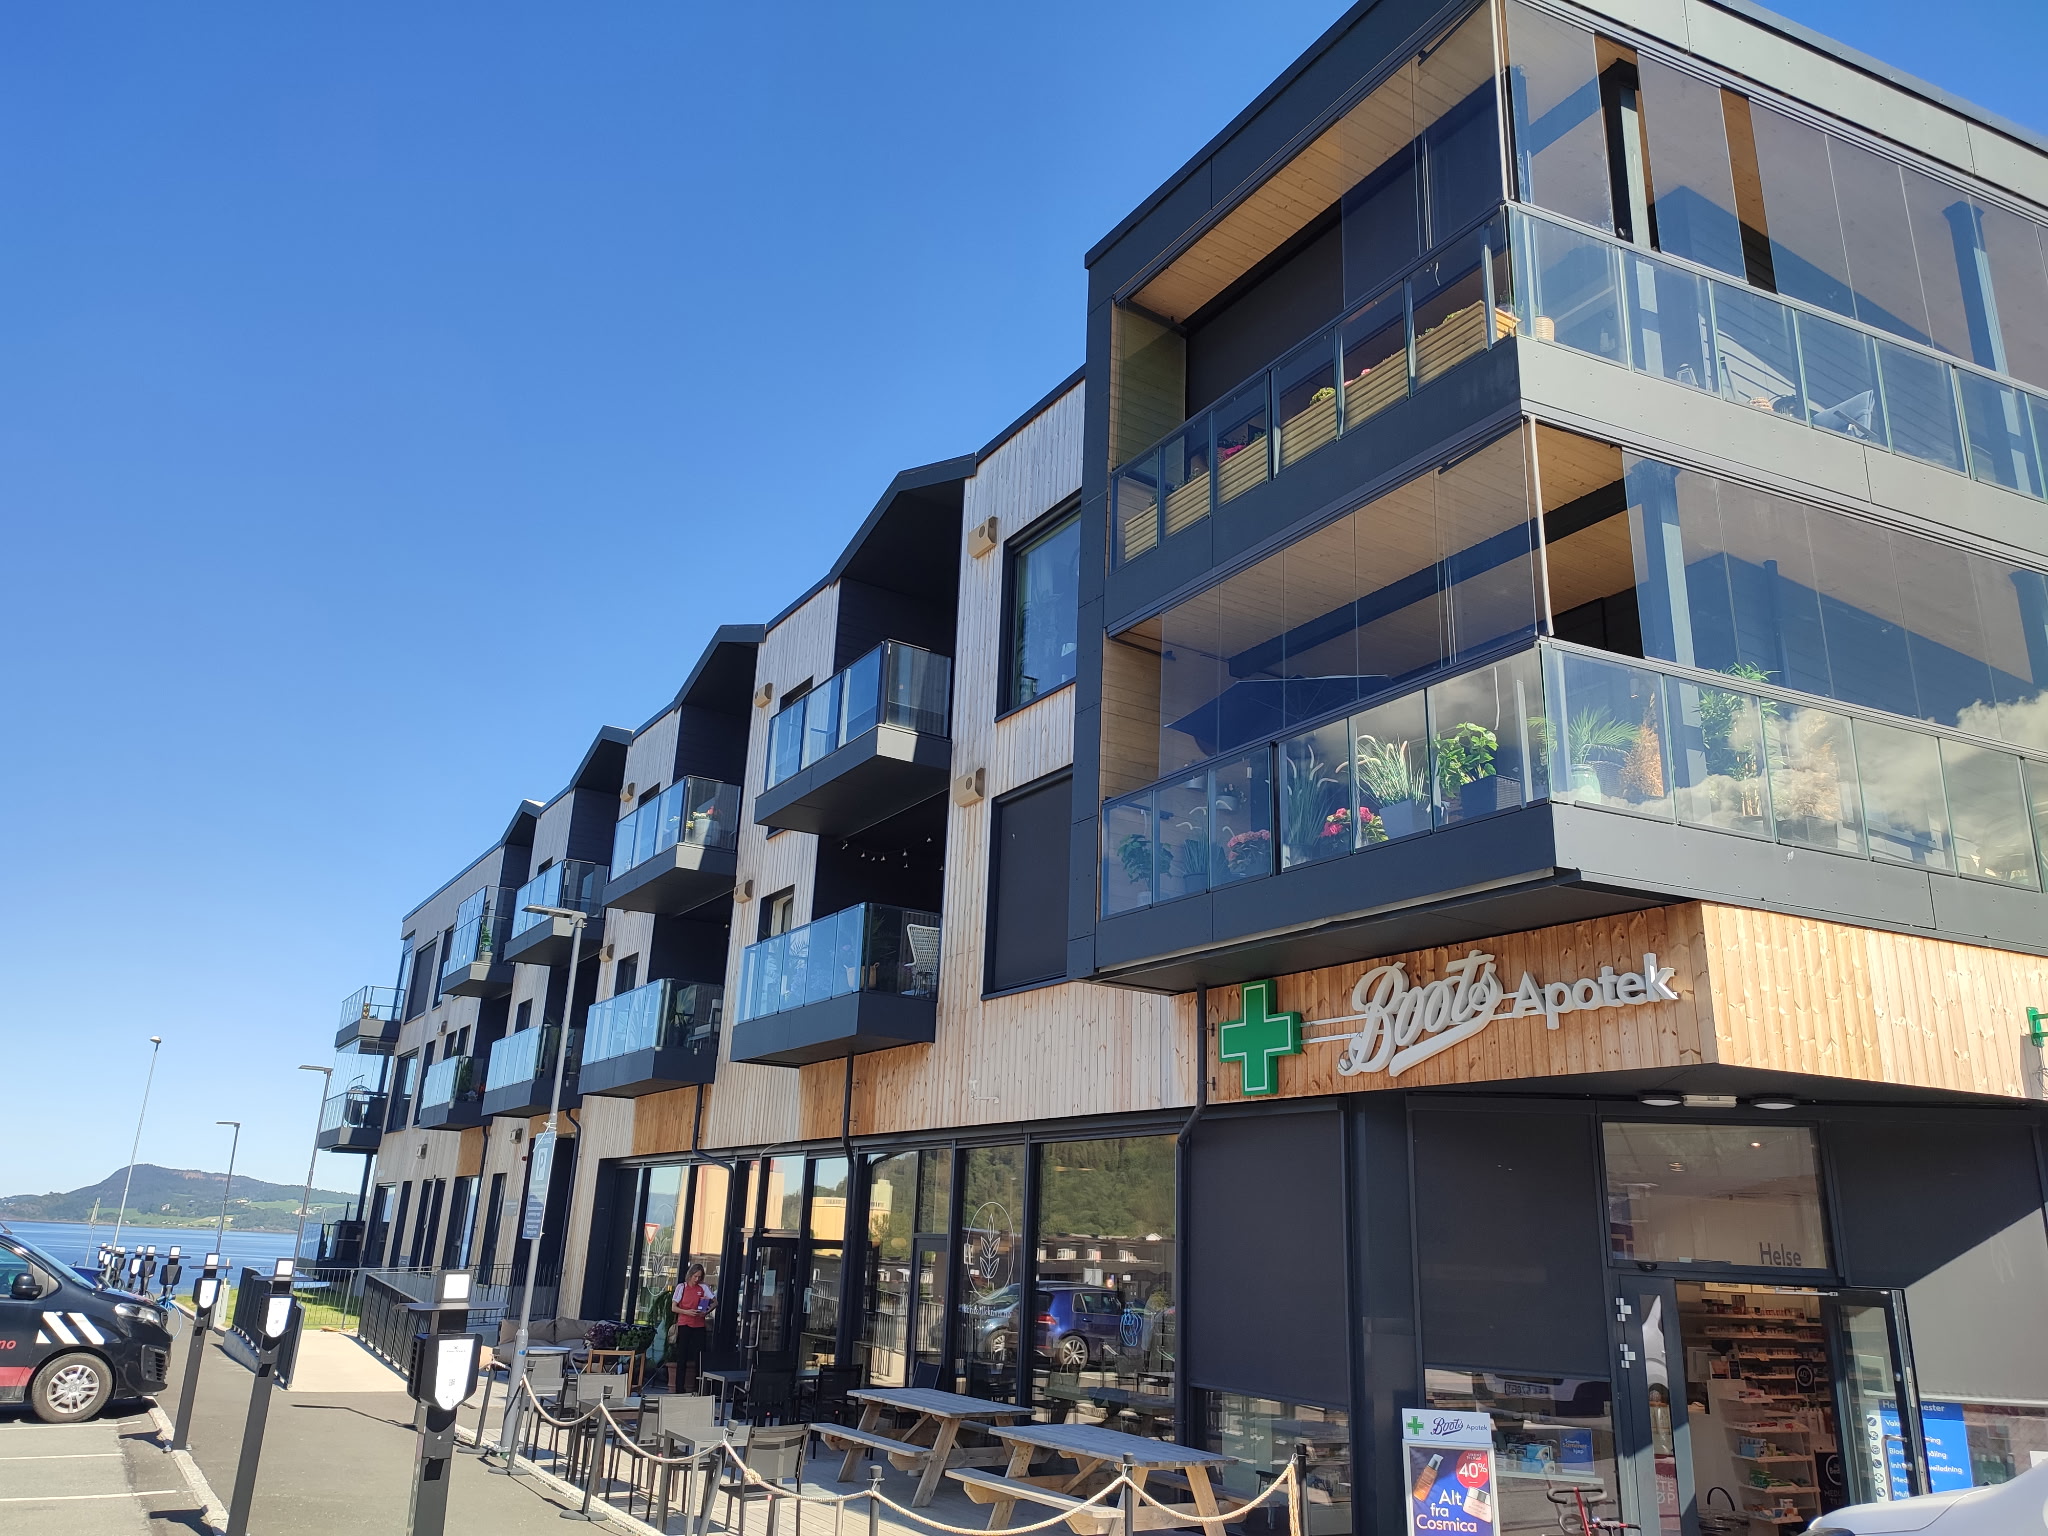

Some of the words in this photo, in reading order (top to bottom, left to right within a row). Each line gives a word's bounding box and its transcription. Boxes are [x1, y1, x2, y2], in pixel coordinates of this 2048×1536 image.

[1337, 950, 1503, 1077] Boots
[1512, 953, 1679, 1030] Apotek
[1759, 1242, 1802, 1267] Helse
[1430, 1416, 1464, 1436] Boots
[1466, 1424, 1488, 1432] Apotek
[1458, 1462, 1488, 1478] 40%
[1438, 1489, 1463, 1506] Alt
[1430, 1503, 1449, 1518] fra
[1416, 1514, 1477, 1533] Cosmica
